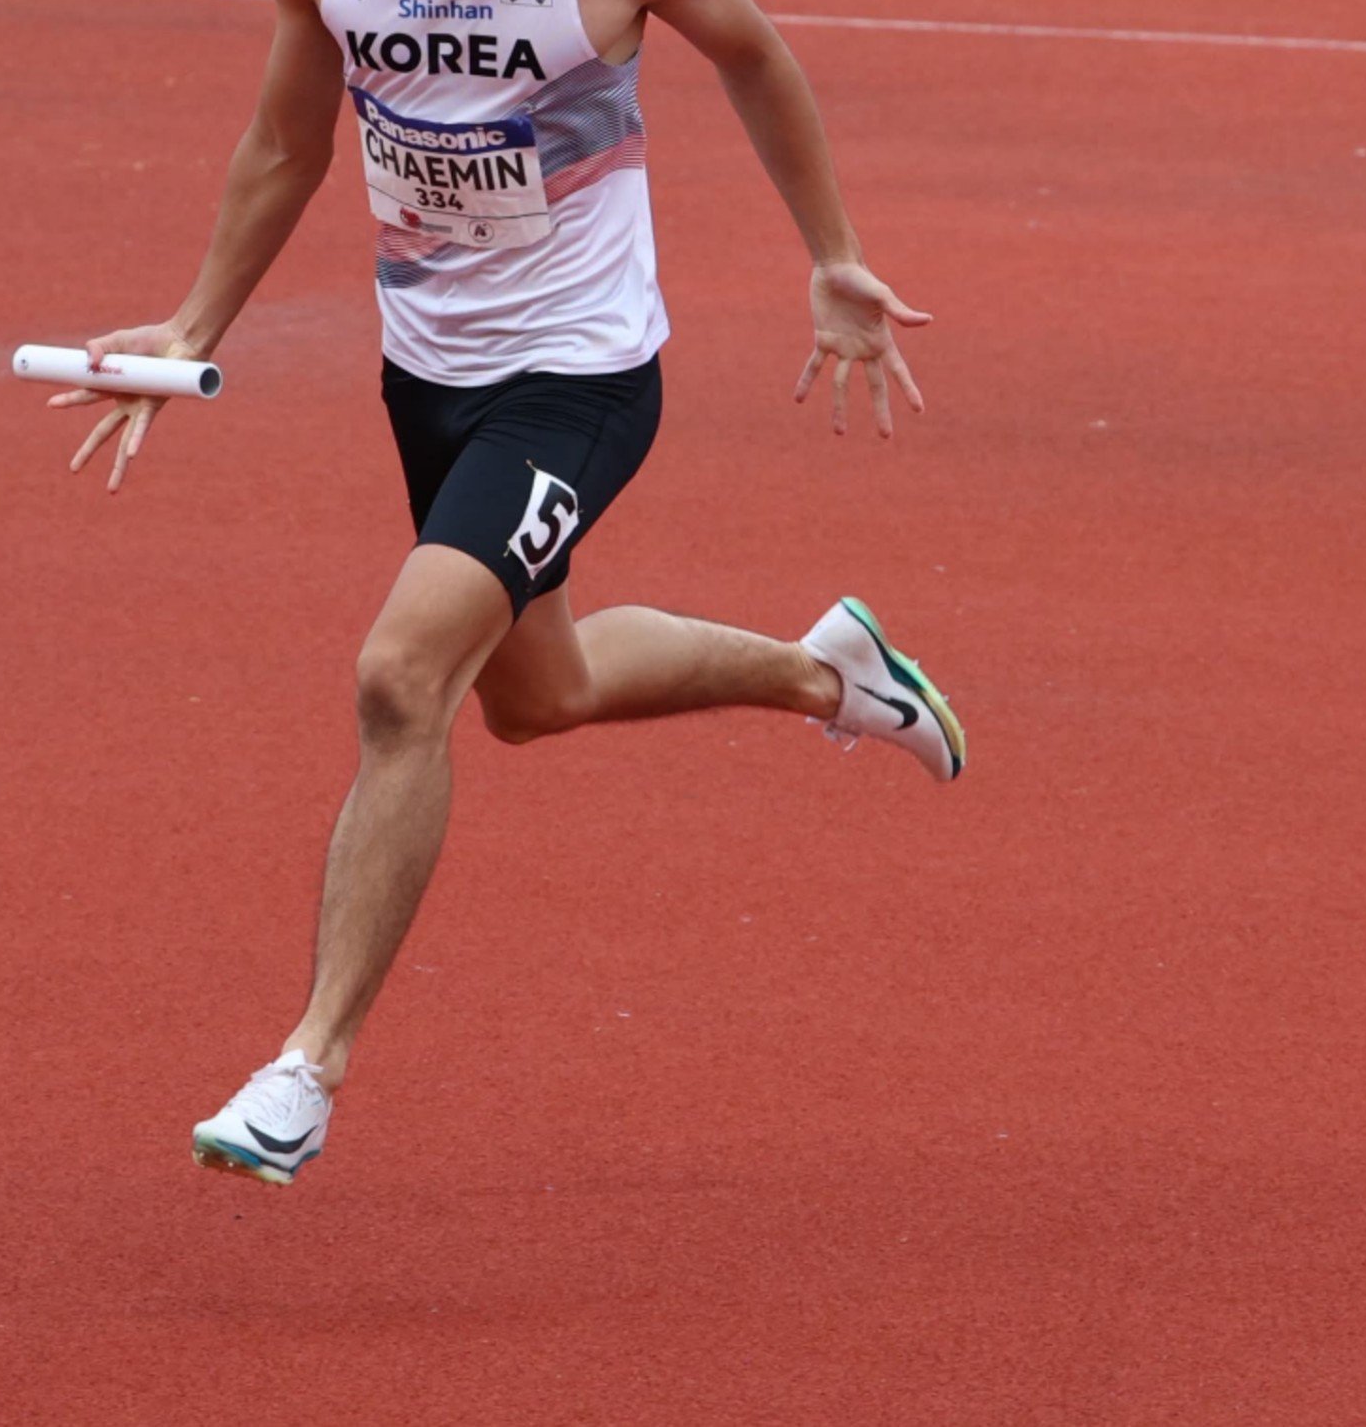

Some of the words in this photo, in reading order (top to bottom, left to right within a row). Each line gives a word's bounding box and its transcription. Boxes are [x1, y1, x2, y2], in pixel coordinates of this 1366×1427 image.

[345, 30, 547, 81] KOREA
[364, 98, 507, 151] Panasonic
[365, 128, 528, 191] CHAEMIN
[415, 188, 464, 211] 334
[520, 480, 576, 566] 5
